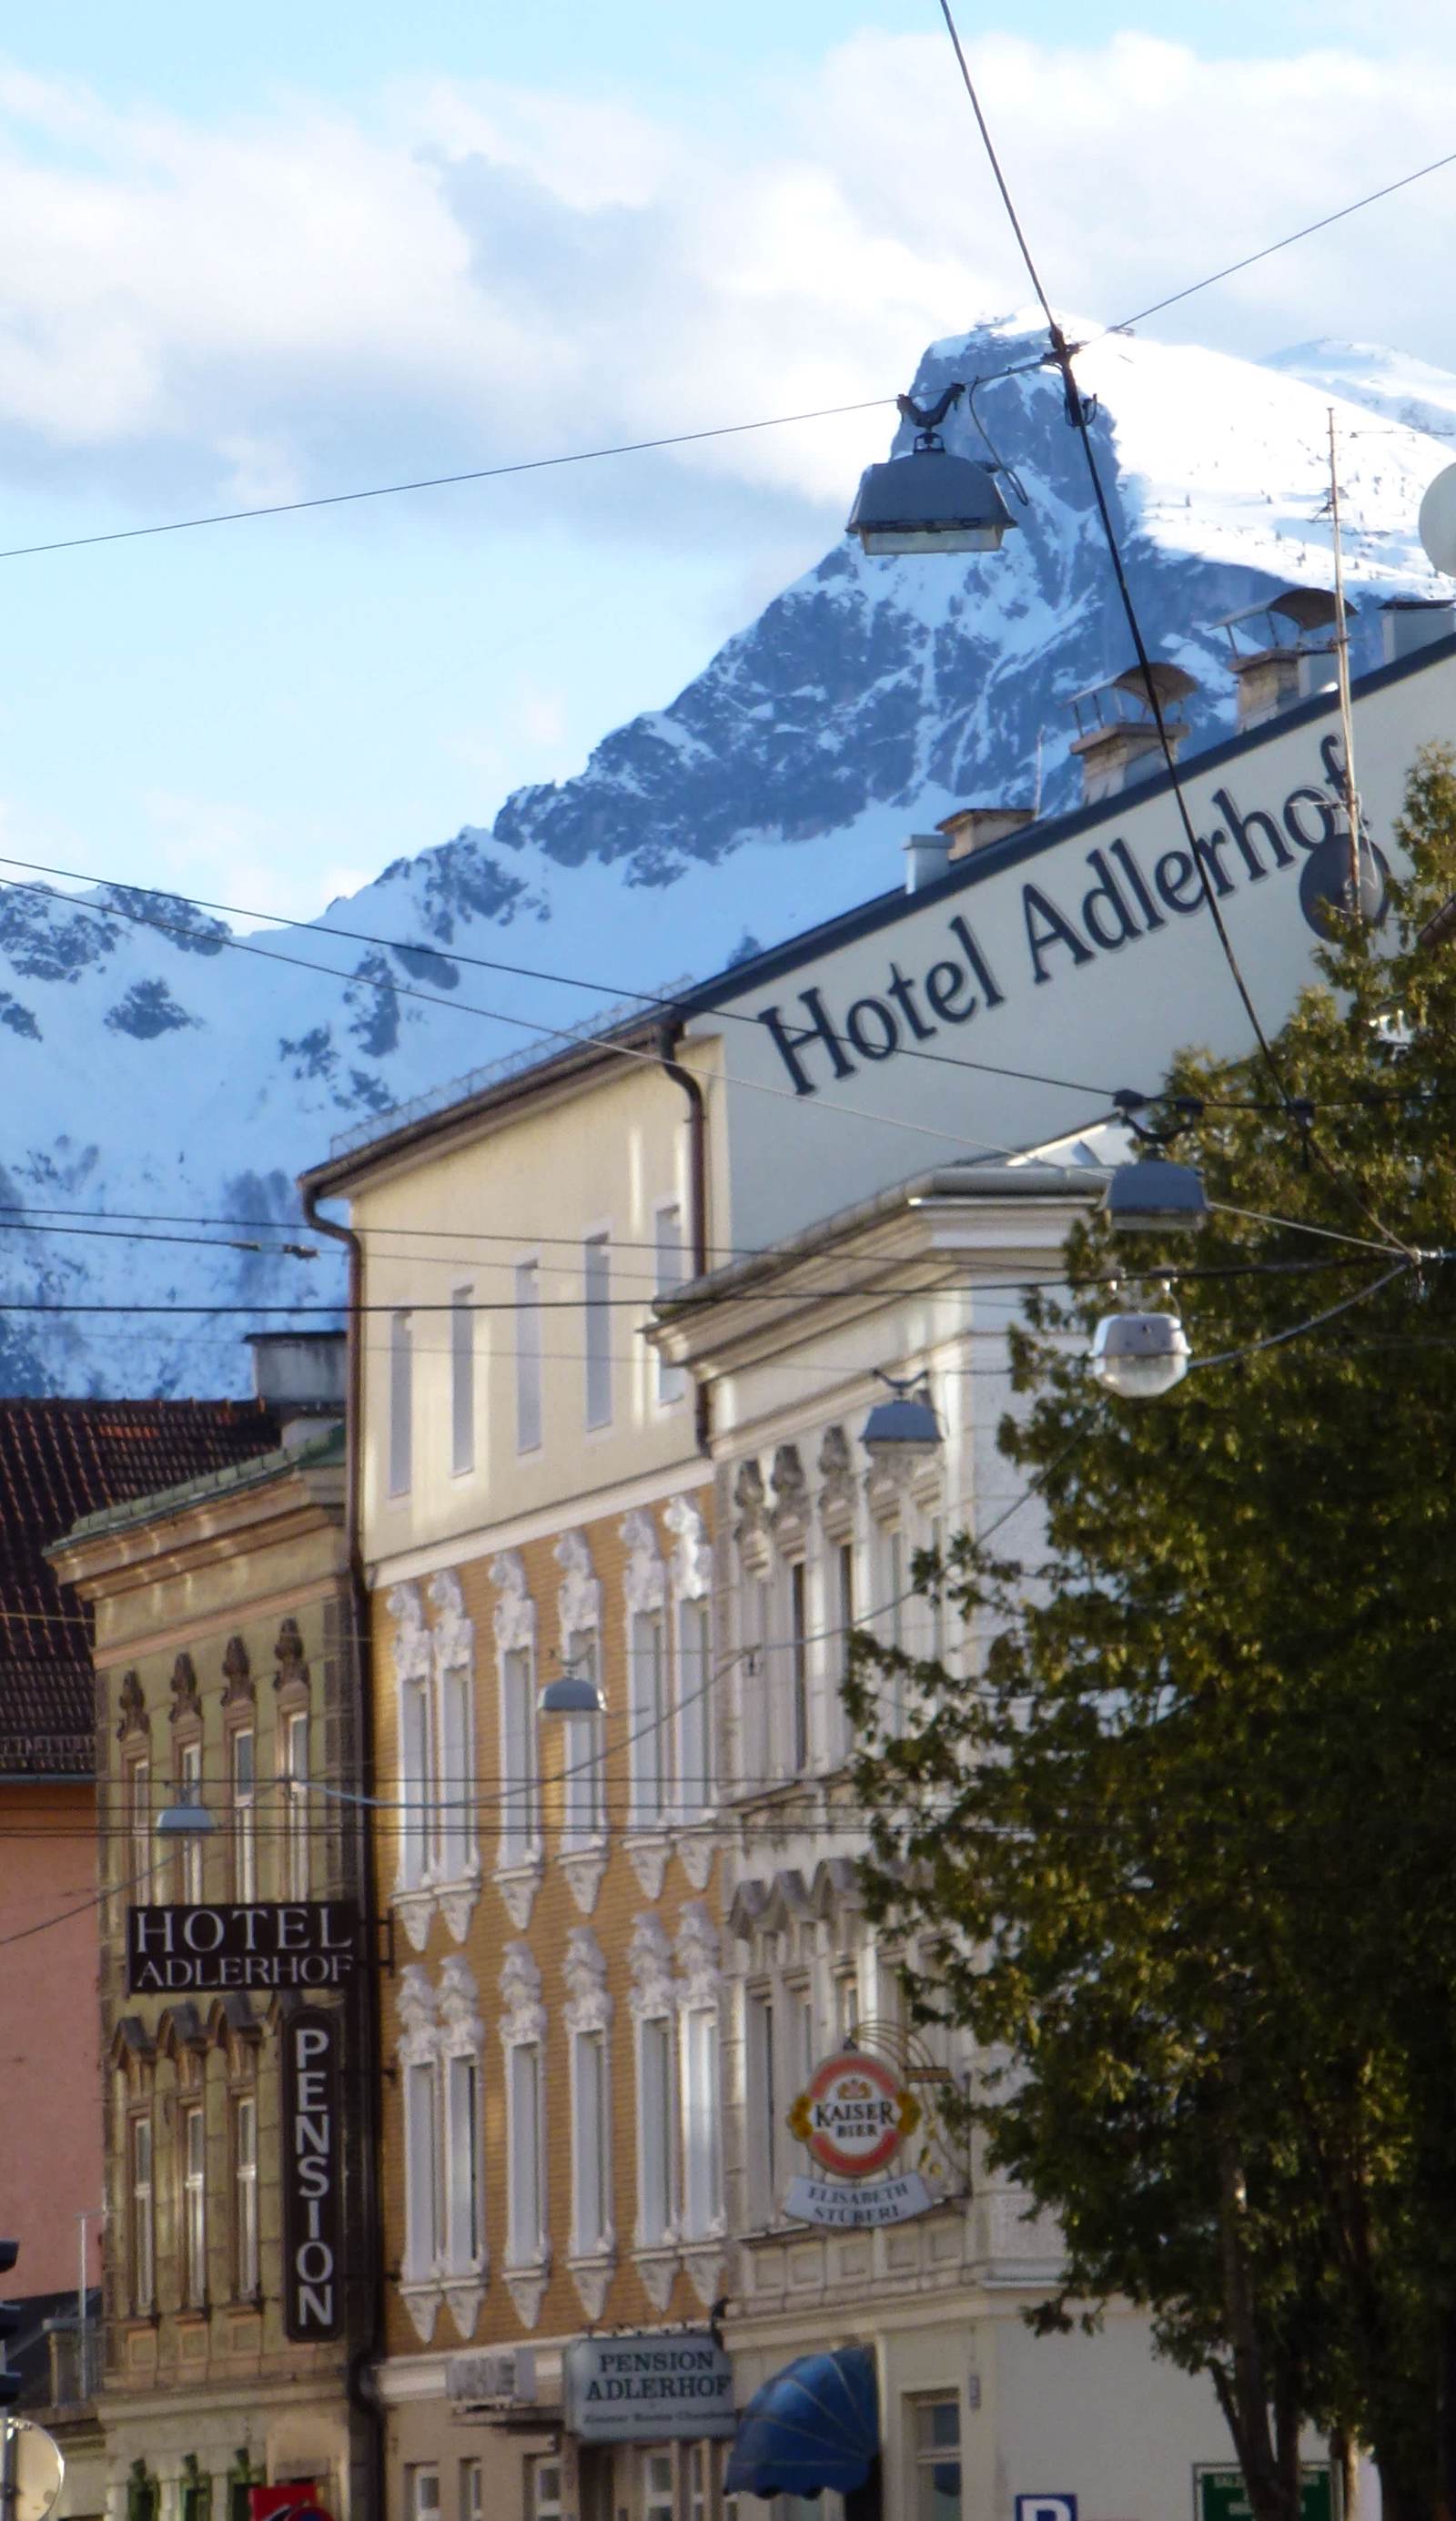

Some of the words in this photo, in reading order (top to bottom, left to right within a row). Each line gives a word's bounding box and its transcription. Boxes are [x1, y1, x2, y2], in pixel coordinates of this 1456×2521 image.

[757, 914, 1006, 1095] Hotel
[1020, 734, 1370, 985] Adlerhof
[136, 1908, 352, 1954] HOTEL
[136, 1954, 355, 1989] ADLERHOF
[814, 2100, 896, 2128] KAISER
[836, 2123, 879, 2138] BIER
[295, 2028, 335, 2327] PENSION
[599, 2351, 714, 2374] PENSION
[584, 2374, 733, 2402] ADLERHOF
